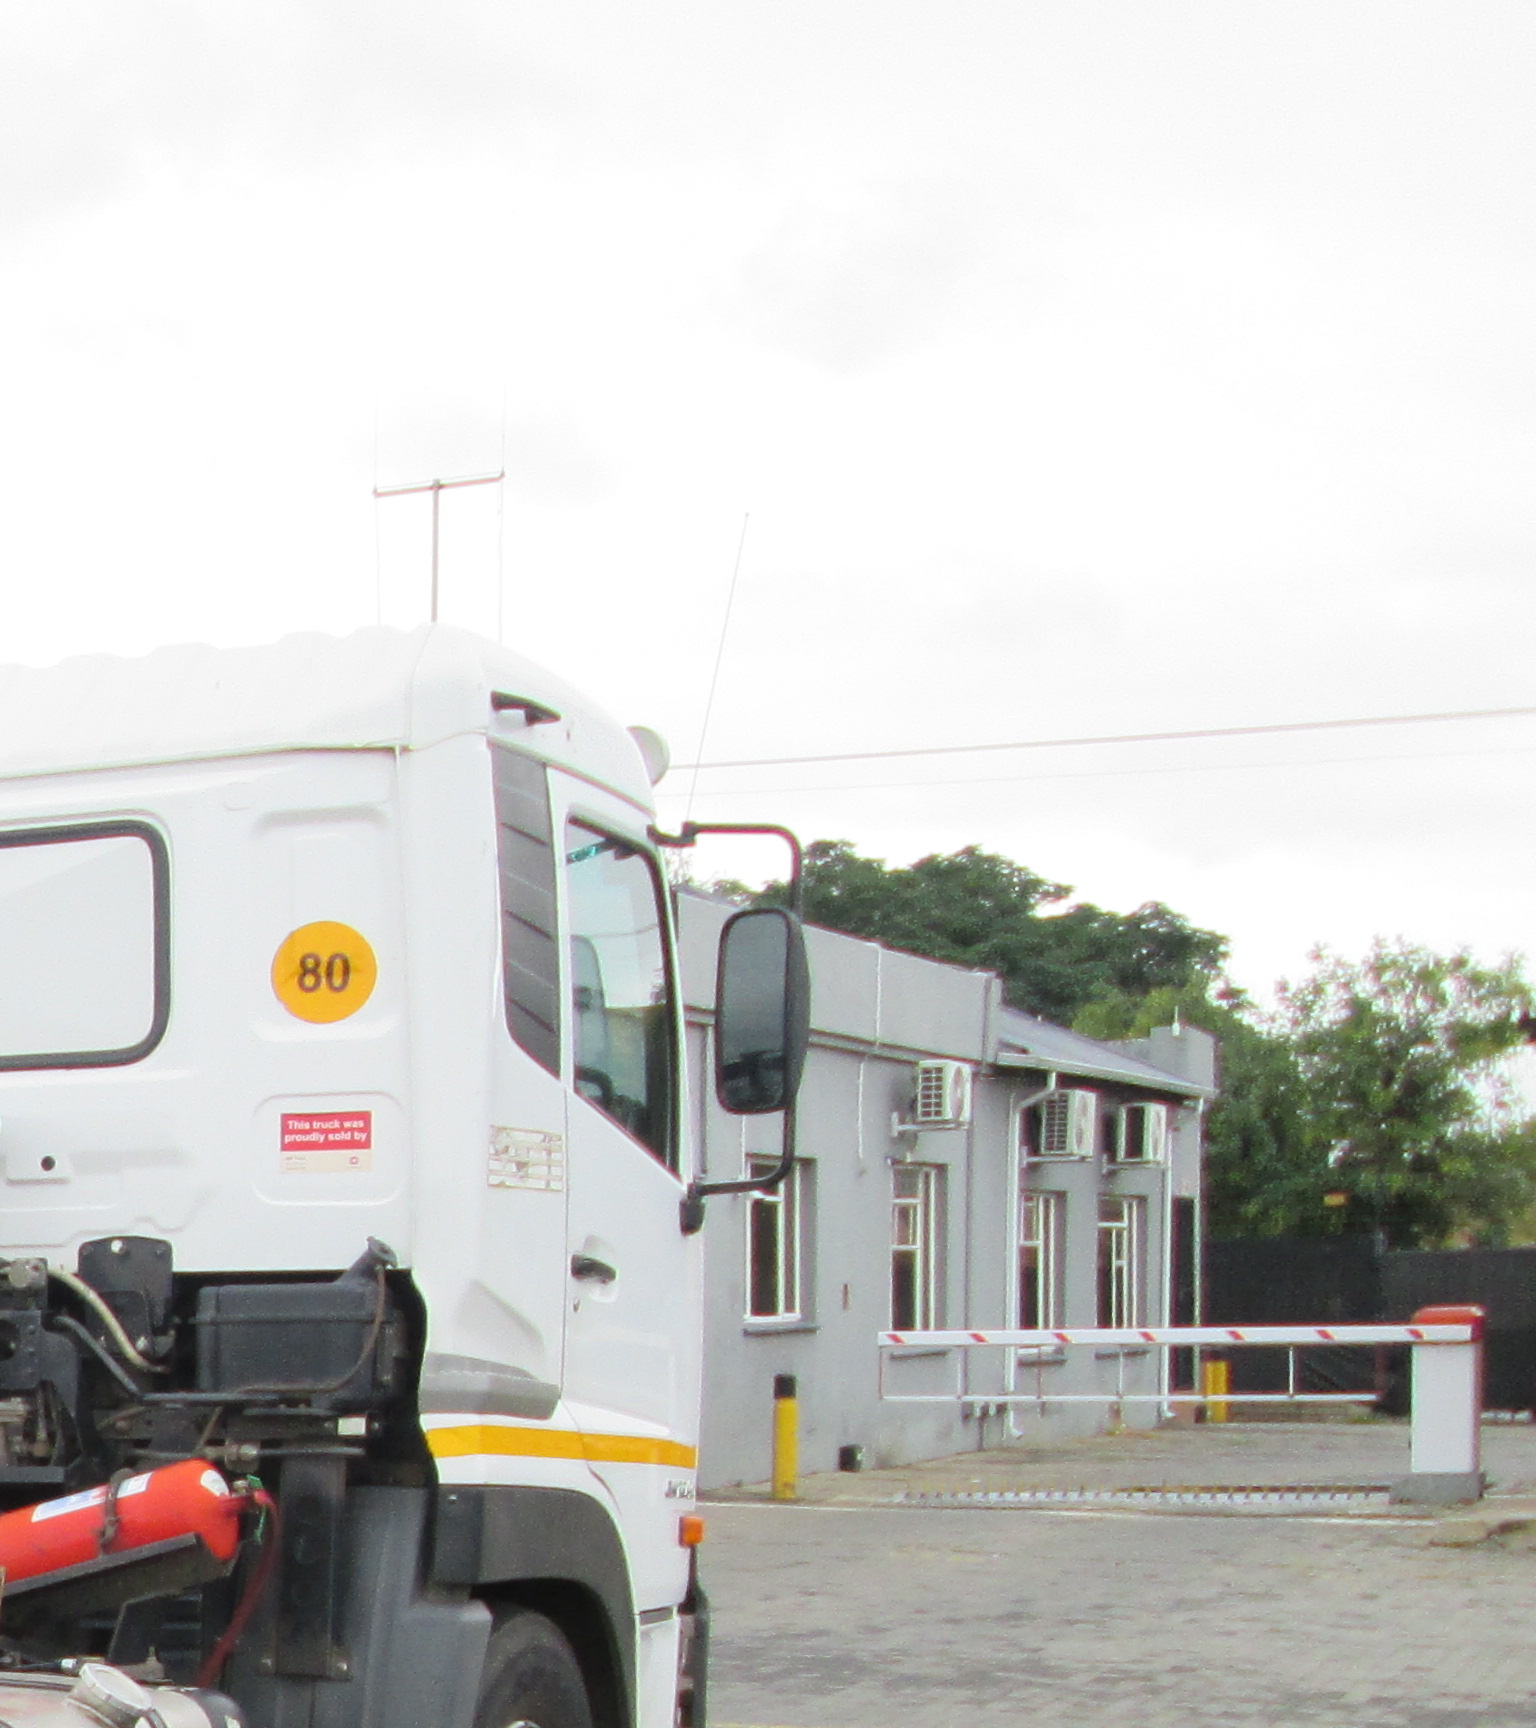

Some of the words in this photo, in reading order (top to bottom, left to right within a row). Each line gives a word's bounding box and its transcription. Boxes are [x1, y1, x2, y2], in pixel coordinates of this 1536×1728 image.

[297, 953, 350, 993] 80
[288, 1120, 310, 1129] This
[313, 1120, 340, 1129] truck
[343, 1120, 364, 1128] was
[285, 1132, 325, 1143] proudly
[328, 1131, 351, 1140] sold
[354, 1131, 367, 1142] by
